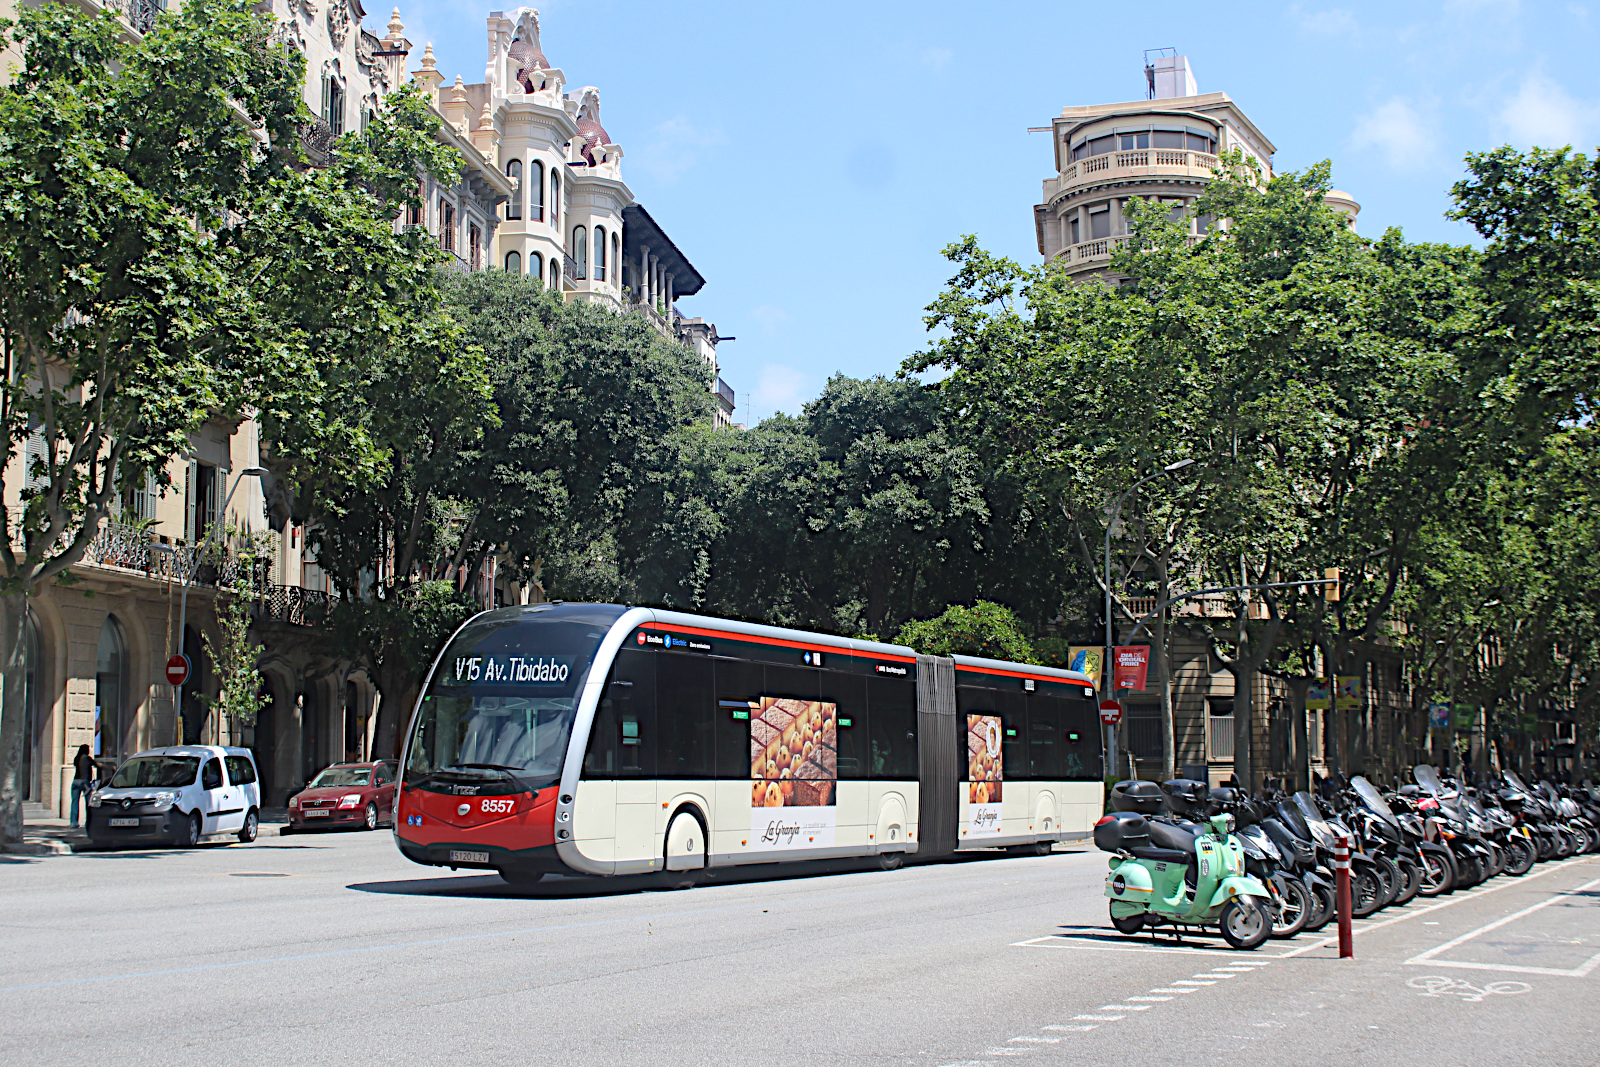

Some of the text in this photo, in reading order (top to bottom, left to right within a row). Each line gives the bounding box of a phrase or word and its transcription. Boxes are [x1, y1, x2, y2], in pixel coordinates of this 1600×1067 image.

[456, 658, 482, 680] V15
[481, 799, 515, 813] 8557
[761, 820, 800, 845] La Granja
[454, 852, 487, 862] 5120 LZV
